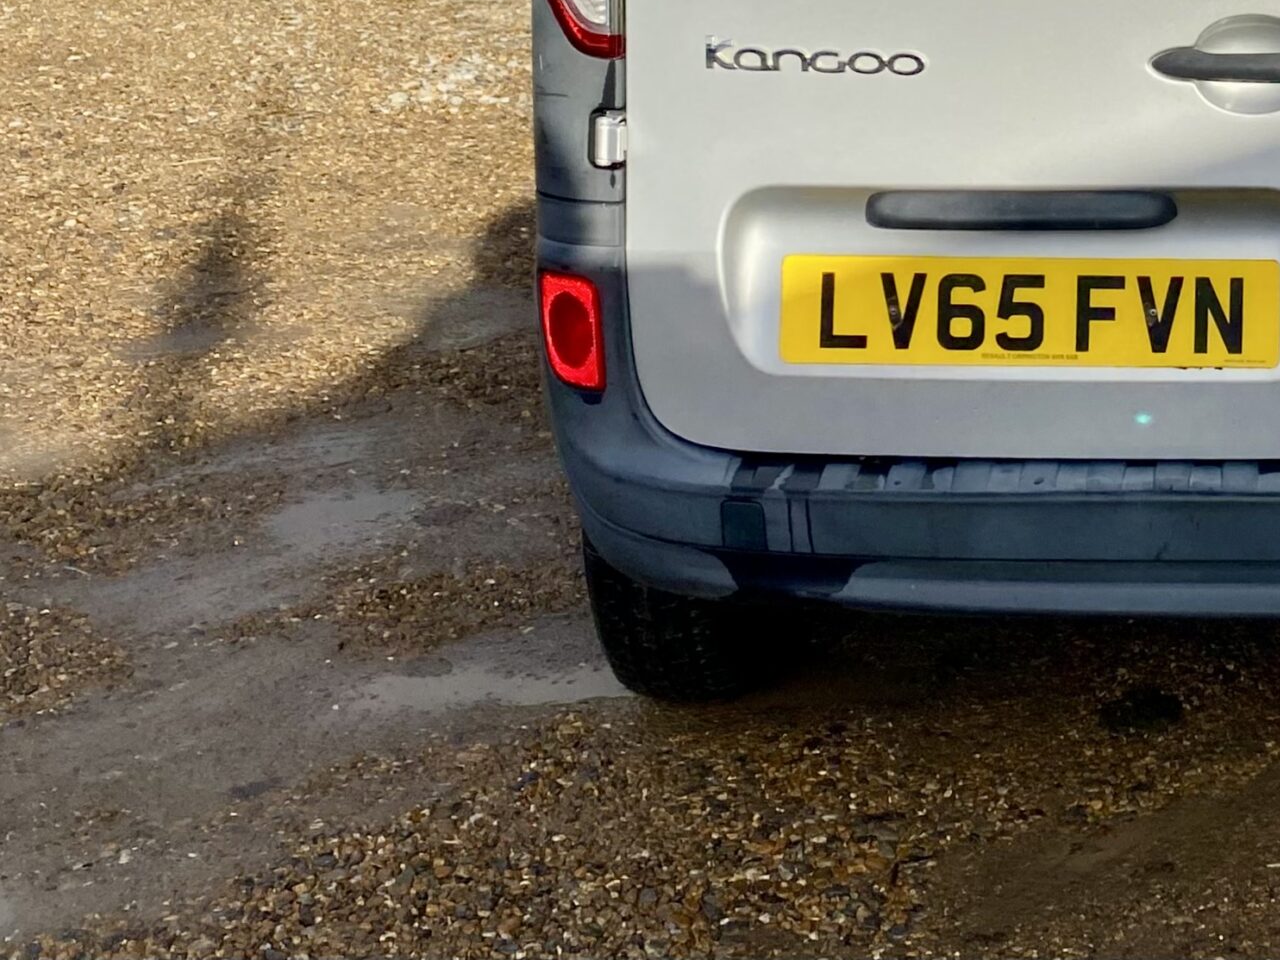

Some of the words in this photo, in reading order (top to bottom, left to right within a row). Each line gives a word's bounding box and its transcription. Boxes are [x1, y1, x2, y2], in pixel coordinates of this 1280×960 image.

[705, 35, 925, 76] Kangoo
[819, 272, 1046, 350] LV65
[1075, 275, 1245, 354] FVN
